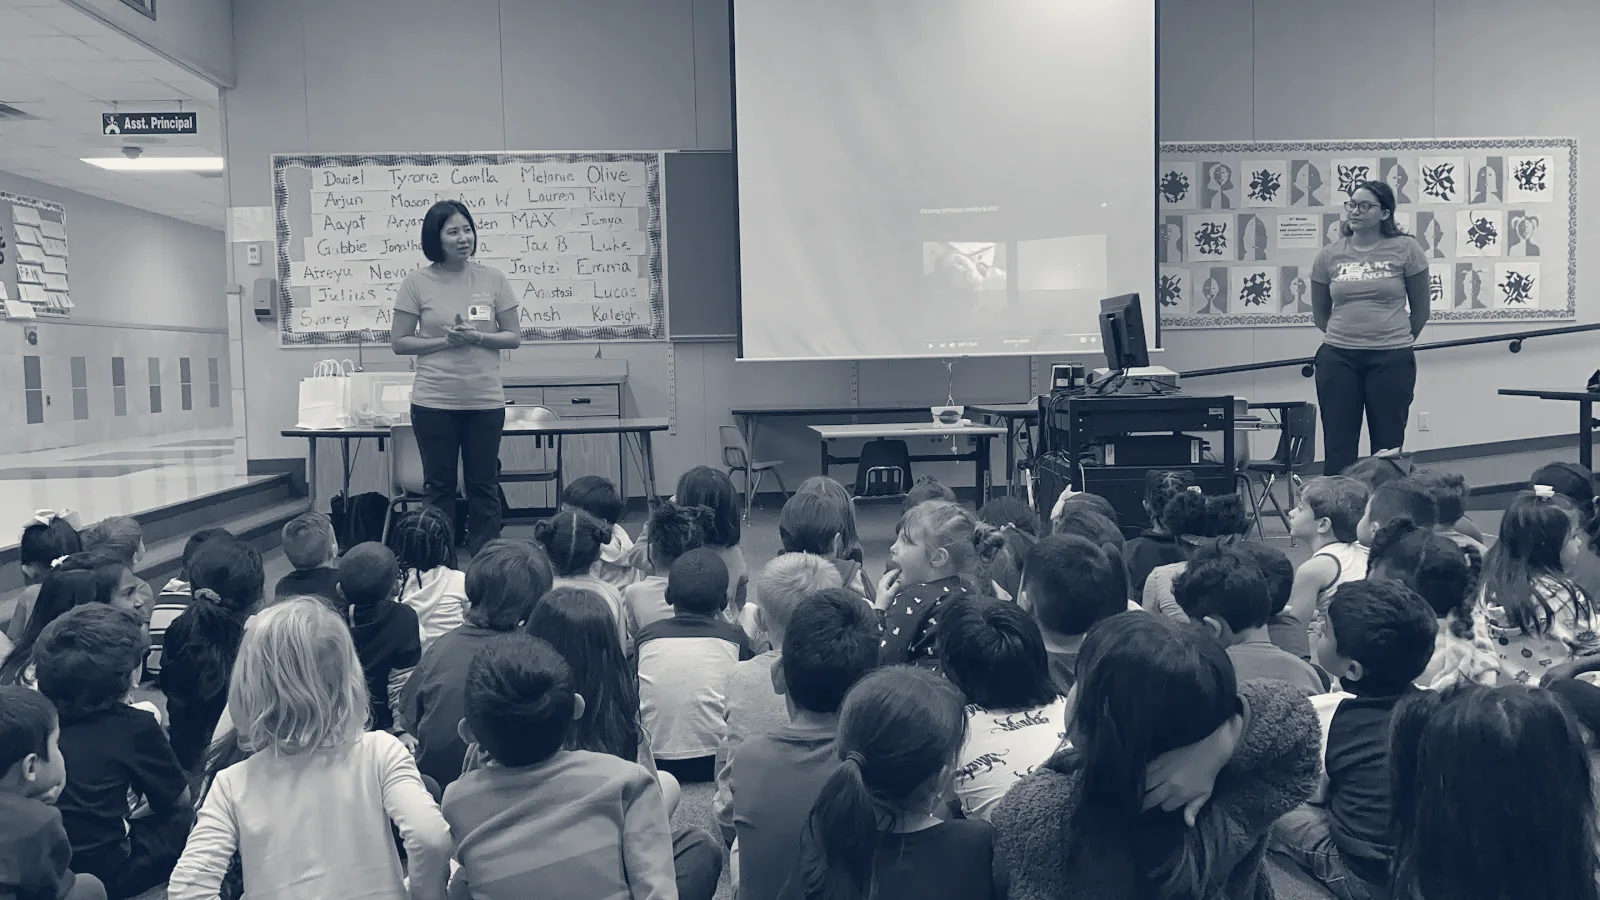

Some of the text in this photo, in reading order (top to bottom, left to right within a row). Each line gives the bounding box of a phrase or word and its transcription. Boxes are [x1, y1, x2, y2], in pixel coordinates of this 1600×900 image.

[124, 116, 193, 131] Asst. Principal
[324, 169, 364, 187] Daniel
[388, 169, 439, 190] Tyrone
[521, 165, 575, 183] Melanie
[587, 165, 631, 184] Olive
[324, 192, 363, 209] Arjun
[391, 194, 430, 208] Mason
[528, 188, 575, 202] Lauren
[588, 186, 626, 208] Riley
[324, 214, 365, 236] Aayat
[511, 212, 556, 229] MAX
[521, 234, 631, 253] Jax B Luke
[369, 262, 420, 280] Neva
[577, 257, 632, 275] Emma
[318, 287, 376, 302] Julius
[593, 281, 638, 299] Lucas
[519, 305, 640, 324] Ansh Kaleigh
